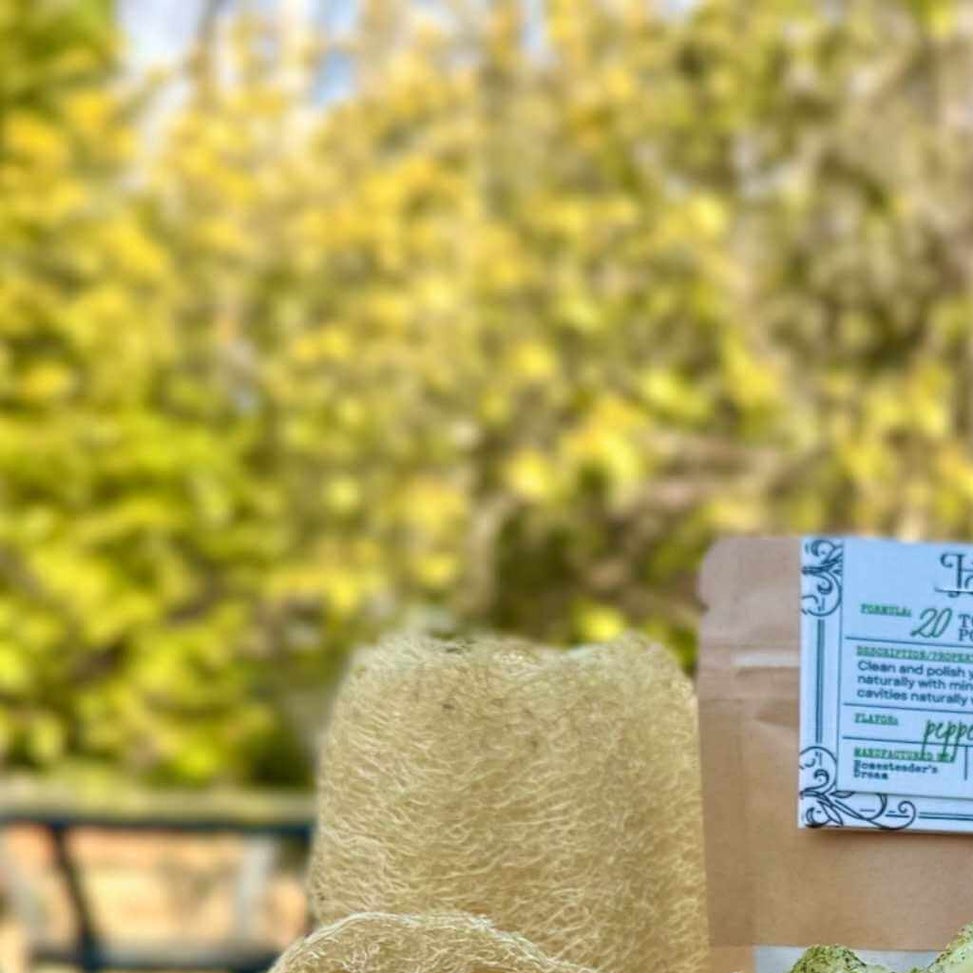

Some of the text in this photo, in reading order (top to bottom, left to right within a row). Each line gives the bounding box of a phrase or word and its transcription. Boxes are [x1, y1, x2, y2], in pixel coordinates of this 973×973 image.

[910, 608, 953, 639] 20
[858, 661, 896, 673] Clean
[899, 663, 923, 675] and
[927, 665, 965, 680] polish
[857, 674, 915, 690] naturally
[918, 677, 948, 690] with
[857, 688, 907, 701] cavities
[911, 691, 969, 706] naturally
